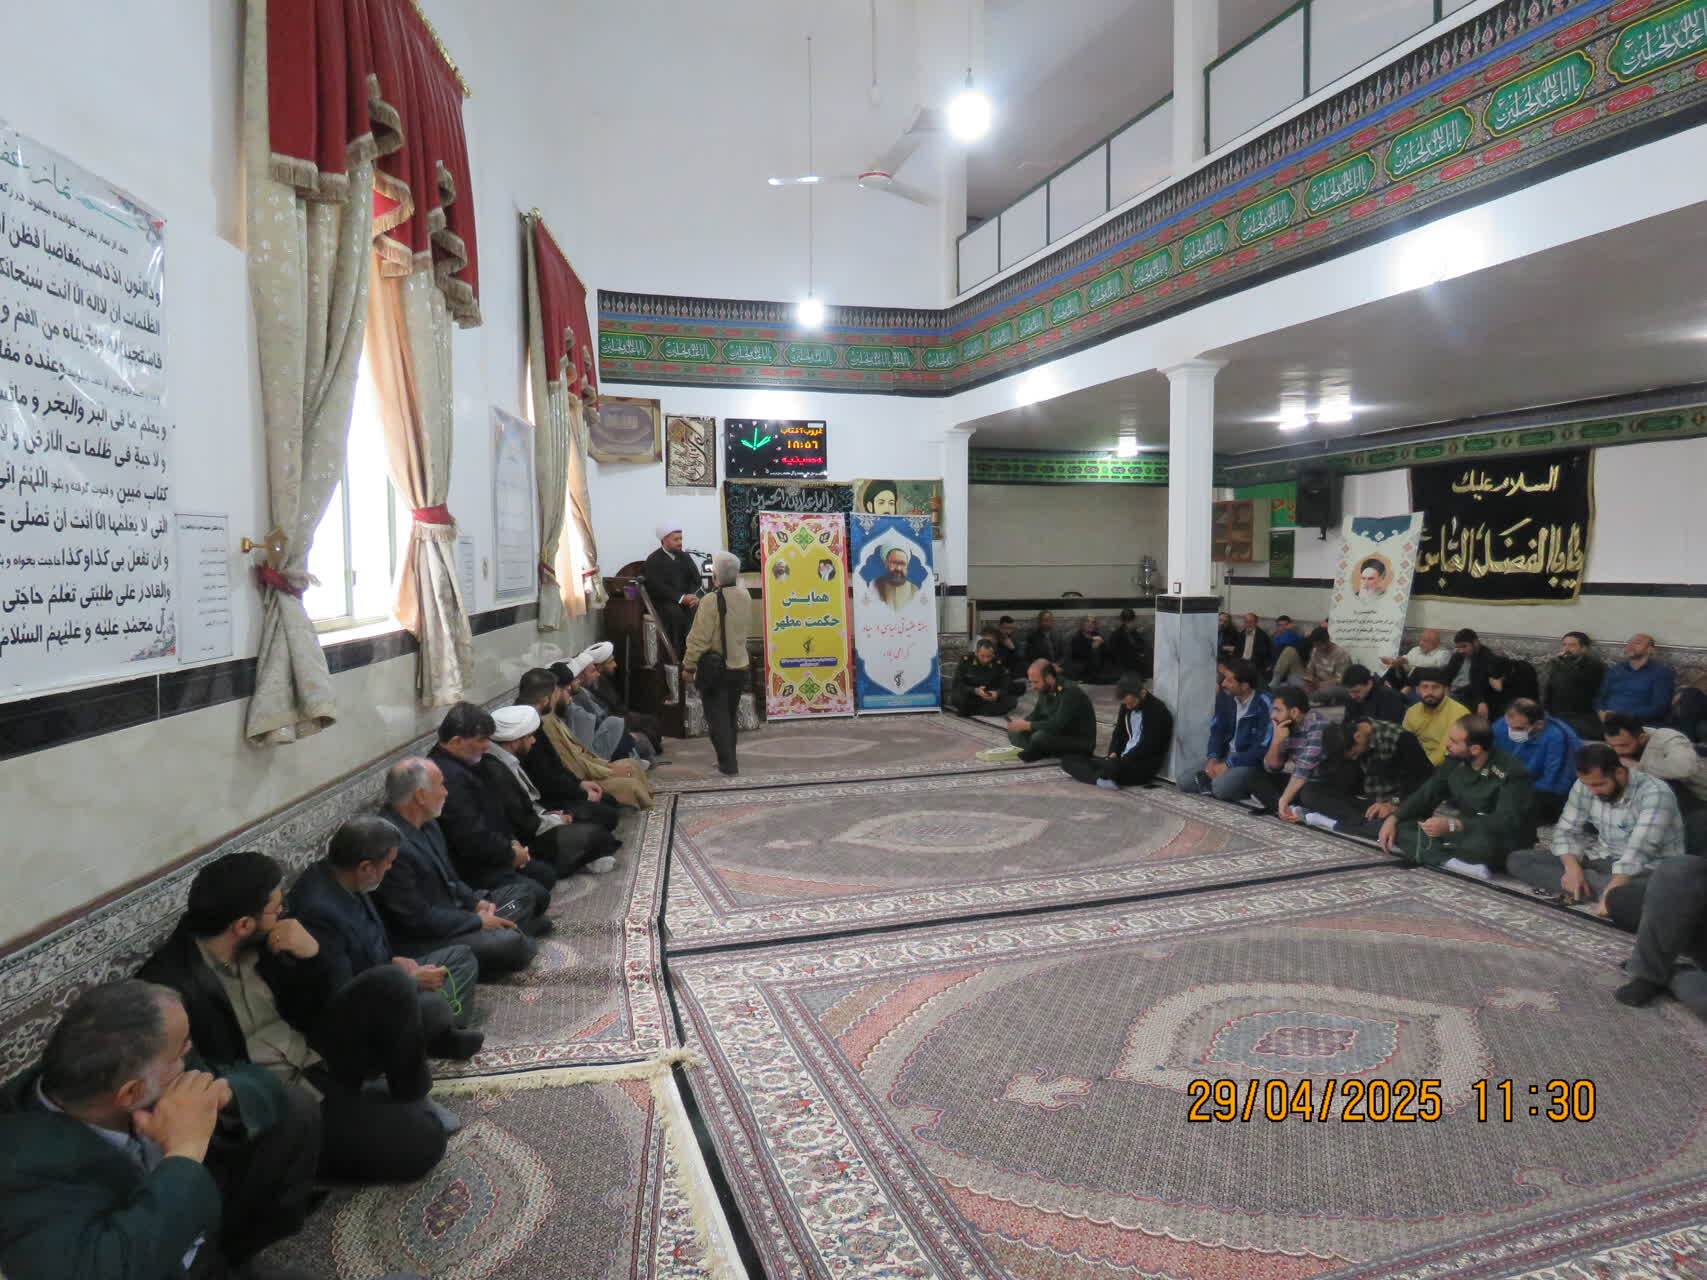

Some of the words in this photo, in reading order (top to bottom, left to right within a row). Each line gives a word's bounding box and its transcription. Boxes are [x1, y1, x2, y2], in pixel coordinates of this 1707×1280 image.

[1452, 469, 1493, 500] علیک
[1491, 464, 1560, 497] السلام
[783, 591, 830, 607] همایش
[773, 616, 801, 631] مطهر
[805, 614, 840, 628] حکمت
